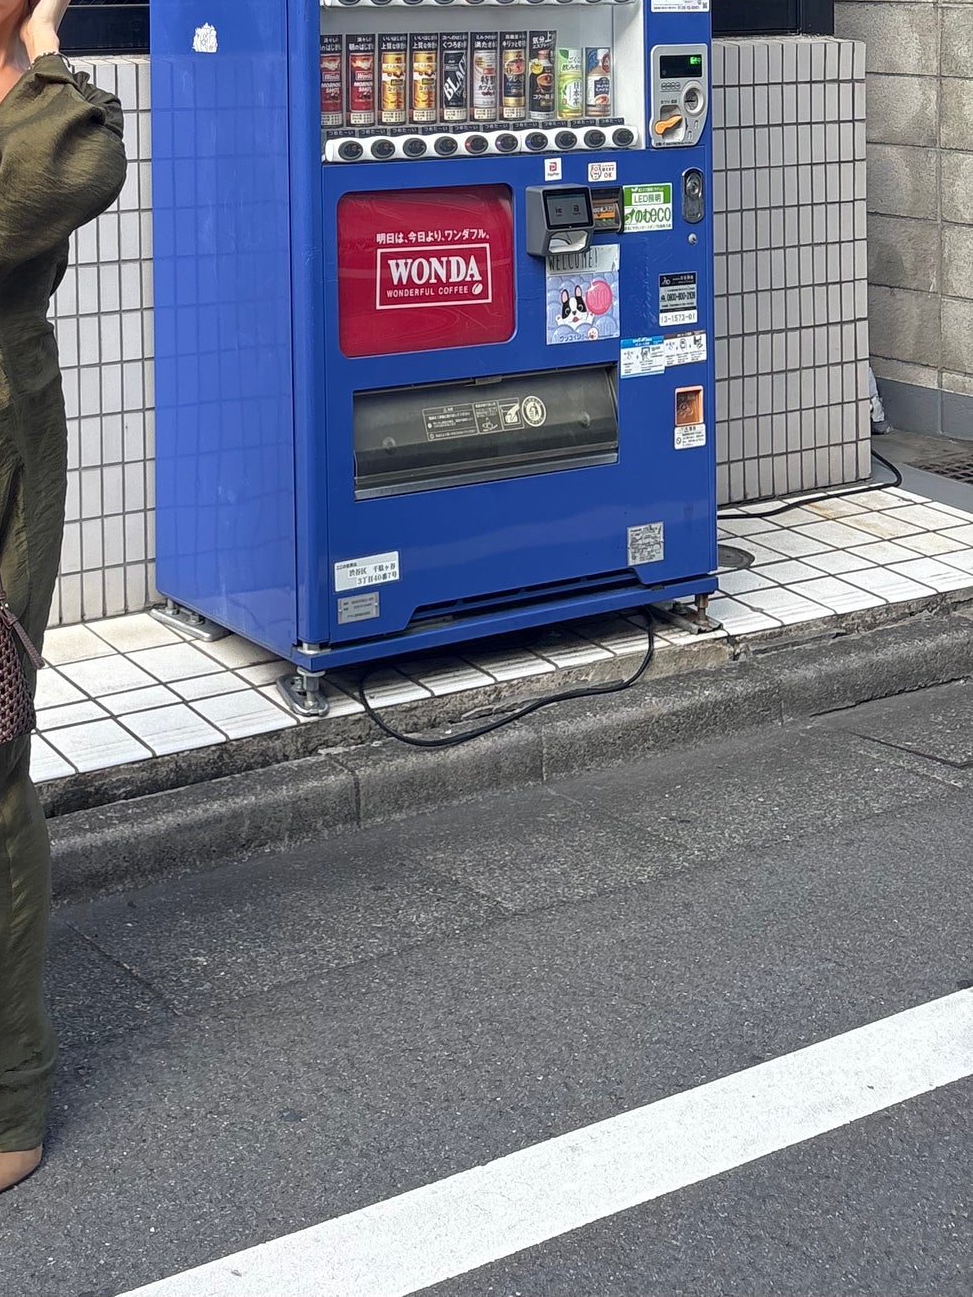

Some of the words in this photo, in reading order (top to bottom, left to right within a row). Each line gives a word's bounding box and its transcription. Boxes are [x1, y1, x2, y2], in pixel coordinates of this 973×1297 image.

[634, 192, 662, 204] LED照明
[376, 229, 489, 244] 明日は、今日より、ワンダフル。
[388, 255, 482, 286] WONDA
[387, 287, 435, 298] WONDERFUL
[438, 285, 469, 295] COFFEE
[349, 567, 367, 577] 渋谷区
